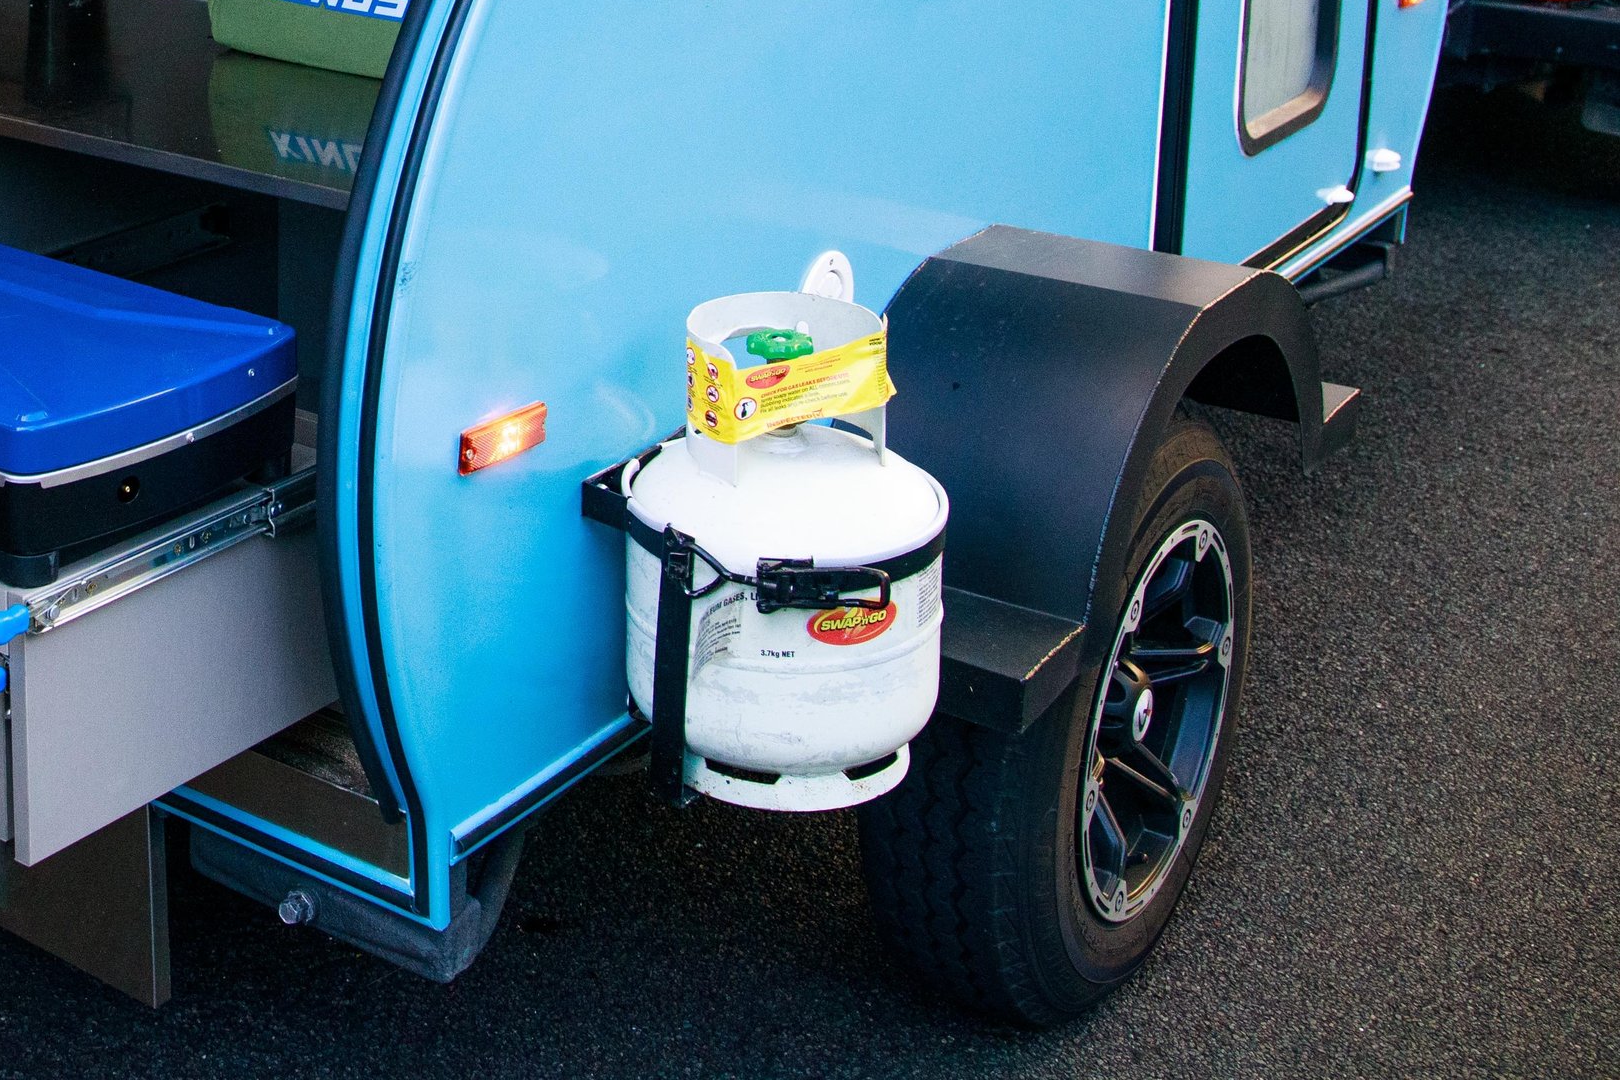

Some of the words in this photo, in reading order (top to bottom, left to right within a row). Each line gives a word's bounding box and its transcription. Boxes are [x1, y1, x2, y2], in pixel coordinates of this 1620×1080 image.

[777, 386, 788, 394] FOR
[799, 379, 816, 388] LEAKS
[816, 375, 837, 384] BEFORE
[767, 413, 812, 428] INSPECTED
[761, 649, 780, 658] 3.7kg
[781, 650, 795, 658] NET
